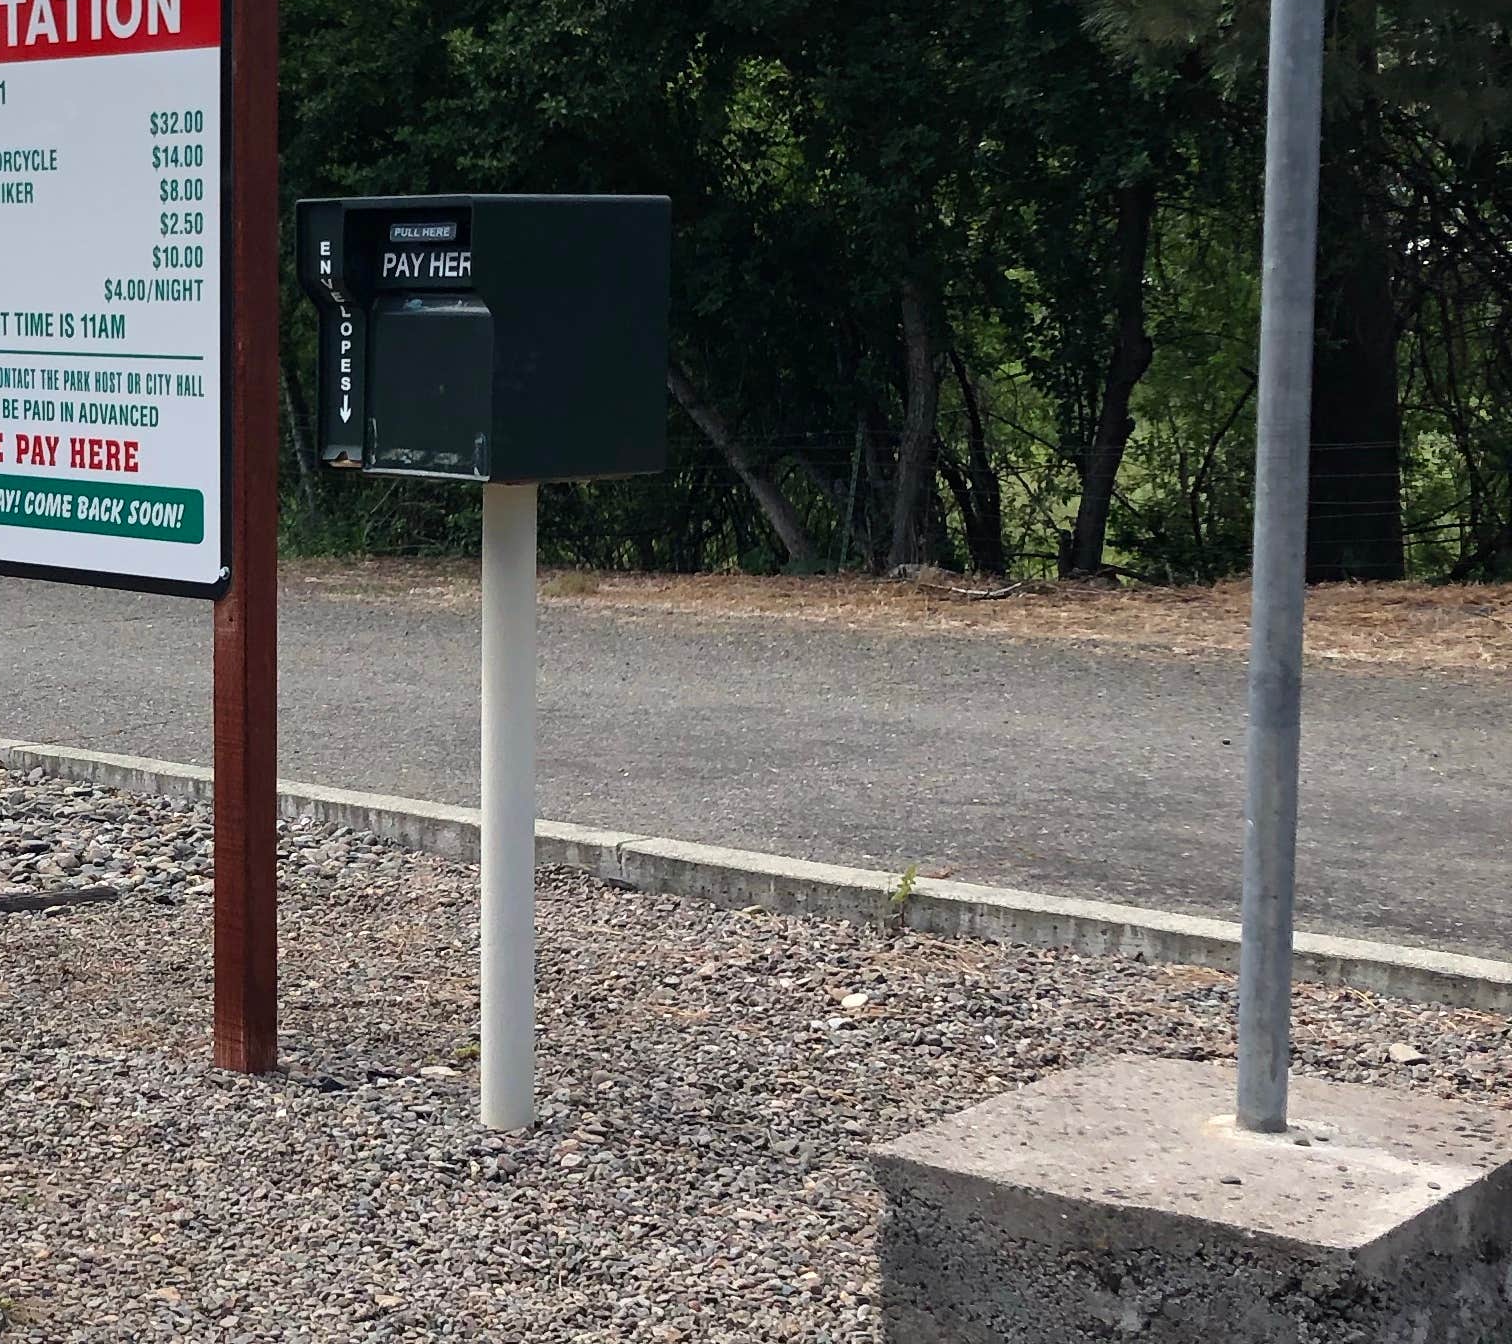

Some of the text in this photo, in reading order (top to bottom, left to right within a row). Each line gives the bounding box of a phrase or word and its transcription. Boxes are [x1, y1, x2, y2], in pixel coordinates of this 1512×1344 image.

[150, 110, 203, 137] $32.00
[152, 144, 203, 170] $14.00
[160, 179, 203, 203] $8.00
[160, 212, 203, 237] $2.50
[394, 227, 450, 237] PULL HERE
[152, 245, 203, 270] $10.00
[383, 251, 472, 277] PAY HER
[104, 278, 203, 303] $4.00/NIGHT
[14, 312, 54, 337] TIME
[60, 313, 75, 338] IS
[80, 313, 126, 339] 11AM
[320, 241, 353, 391] ENVELOPES
[41, 369, 60, 390] THE
[63, 370, 90, 392] PARK
[95, 371, 123, 394] HOST
[127, 372, 141, 394] OR
[146, 372, 171, 396] CITY
[176, 374, 205, 398] HALL
[2, 398, 19, 419] BE
[23, 400, 55, 422] PAID
[60, 401, 74, 422] IN
[78, 402, 159, 428] ADVANCED
[15, 434, 60, 467] PAY
[70, 437, 139, 472] HERE
[24, 491, 72, 519] COME
[77, 495, 122, 524] BACK
[127, 501, 184, 529] SOON!
